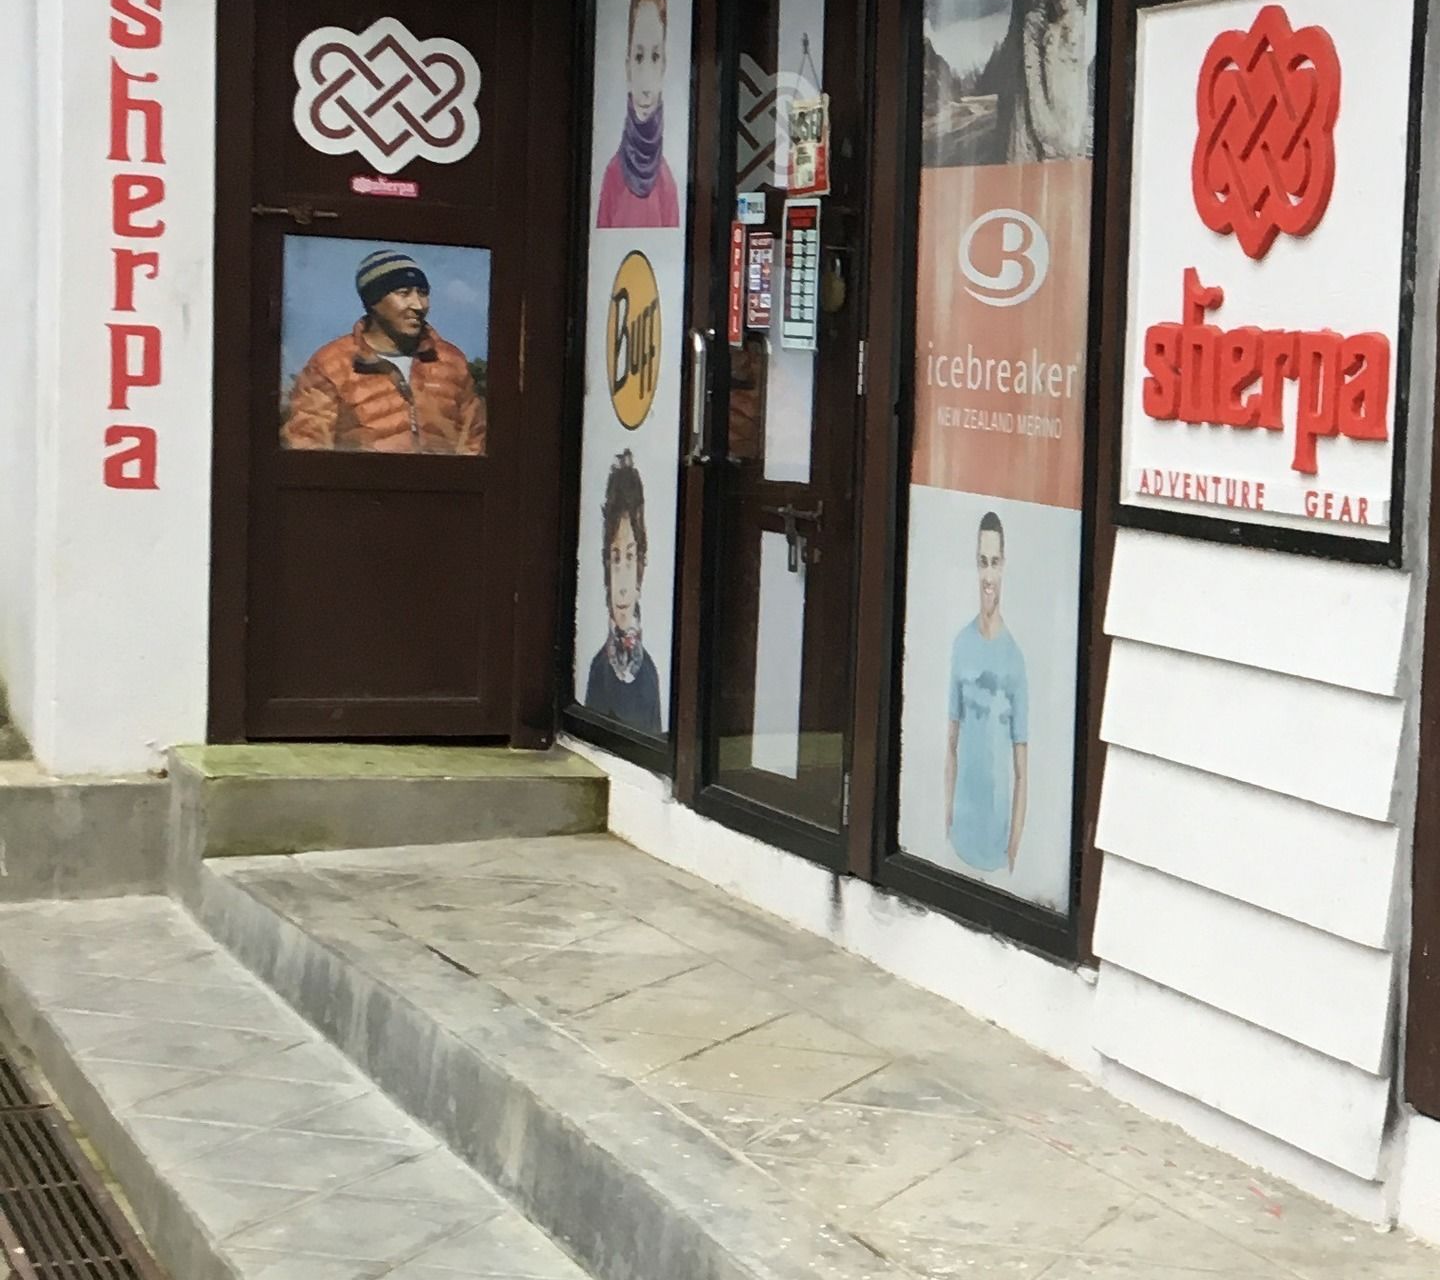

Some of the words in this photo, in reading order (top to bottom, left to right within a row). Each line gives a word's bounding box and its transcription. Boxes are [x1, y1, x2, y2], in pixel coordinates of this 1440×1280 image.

[927, 340, 1078, 399] icebreaker
[1143, 267, 1390, 475] sherpa
[963, 409, 1013, 433] ZEALAND
[1140, 468, 1265, 510] ADVENTURE
[1304, 490, 1369, 526] GEAR
